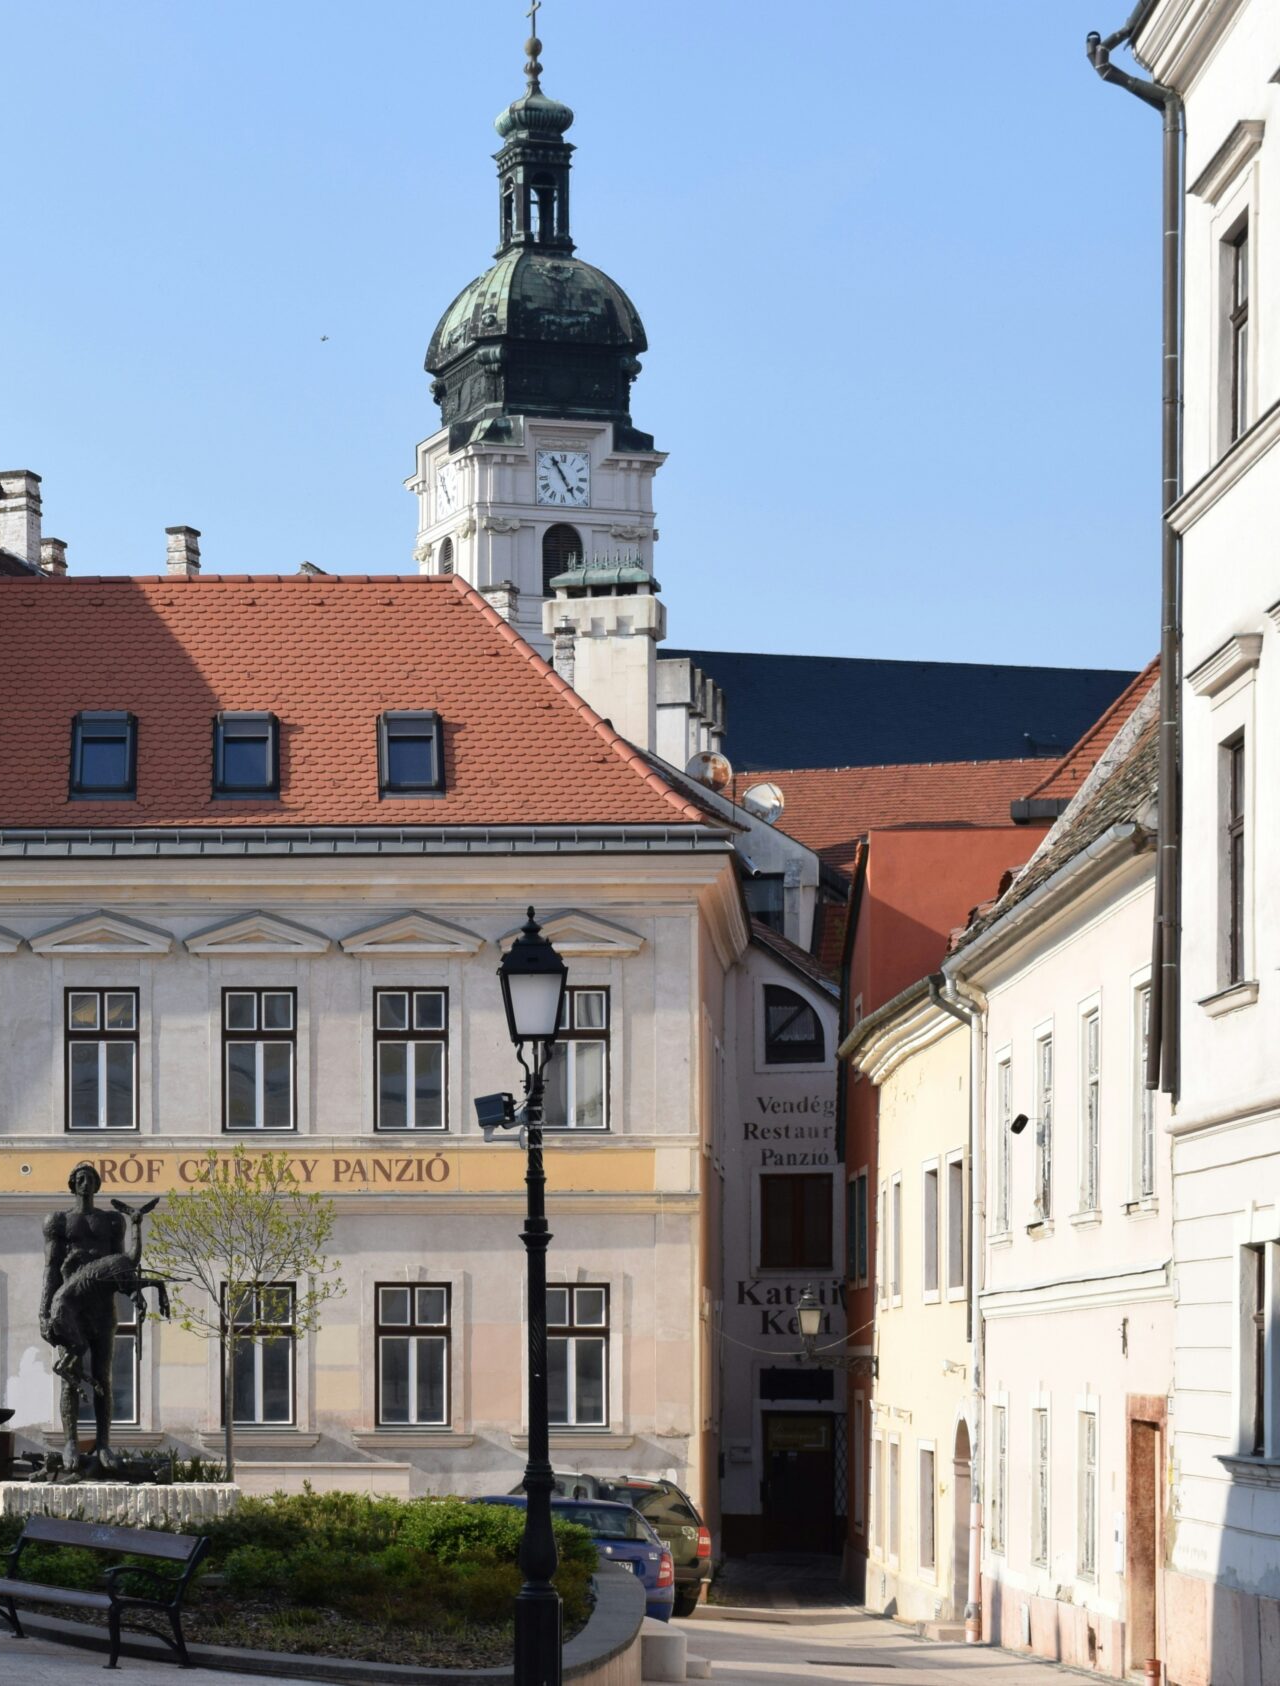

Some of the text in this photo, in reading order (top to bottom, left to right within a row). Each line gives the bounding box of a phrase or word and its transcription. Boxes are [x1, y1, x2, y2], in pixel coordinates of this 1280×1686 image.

[75, 1152, 450, 1183] RÓF CZIRÁKY PANZIÓ
[760, 1147, 829, 1166] Panzió
